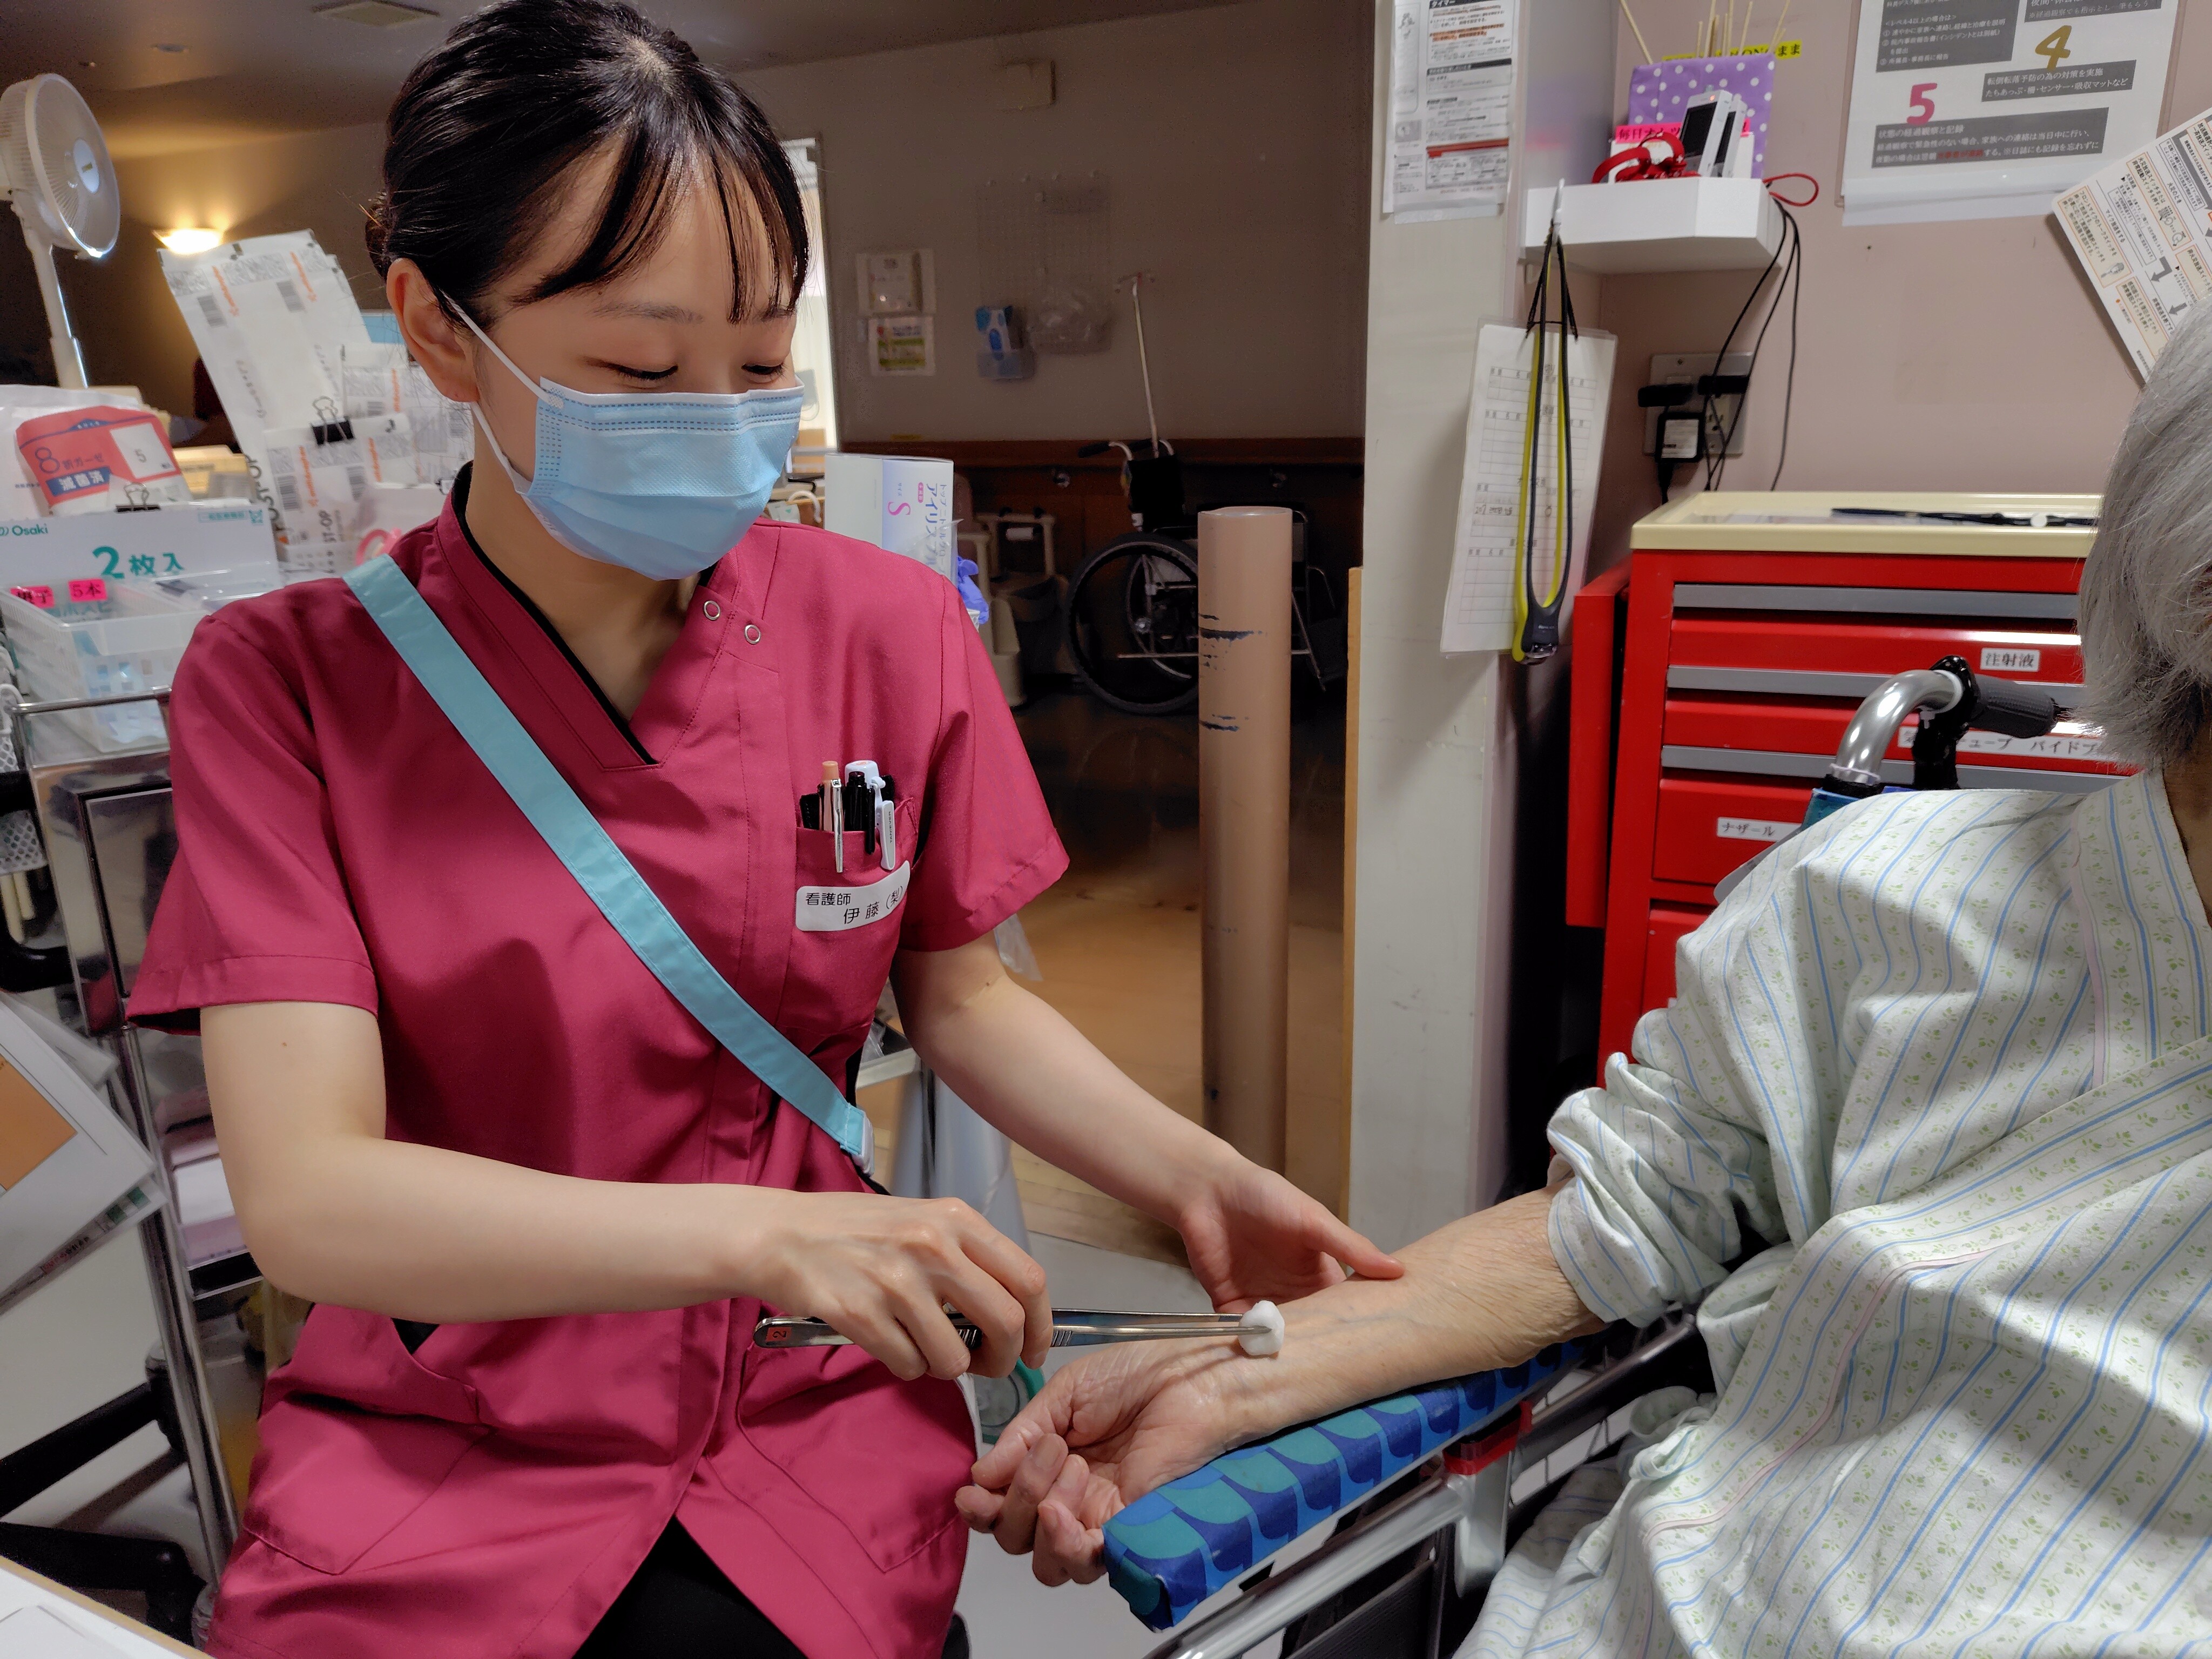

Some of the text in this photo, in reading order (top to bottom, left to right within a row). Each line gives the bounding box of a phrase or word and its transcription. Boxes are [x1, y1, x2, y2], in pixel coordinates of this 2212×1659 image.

[2035, 25, 2072, 71] 4
[1906, 83, 1938, 126] 5
[2167, 181, 2182, 204] 火災のとき
[133, 448, 147, 463] 5
[888, 501, 911, 516] S
[12, 522, 48, 536] Osaki
[1985, 652, 2035, 669] 注射液
[1722, 821, 1776, 837] ナザール
[805, 892, 852, 906] 看護師
[772, 1330, 787, 1338] 2
